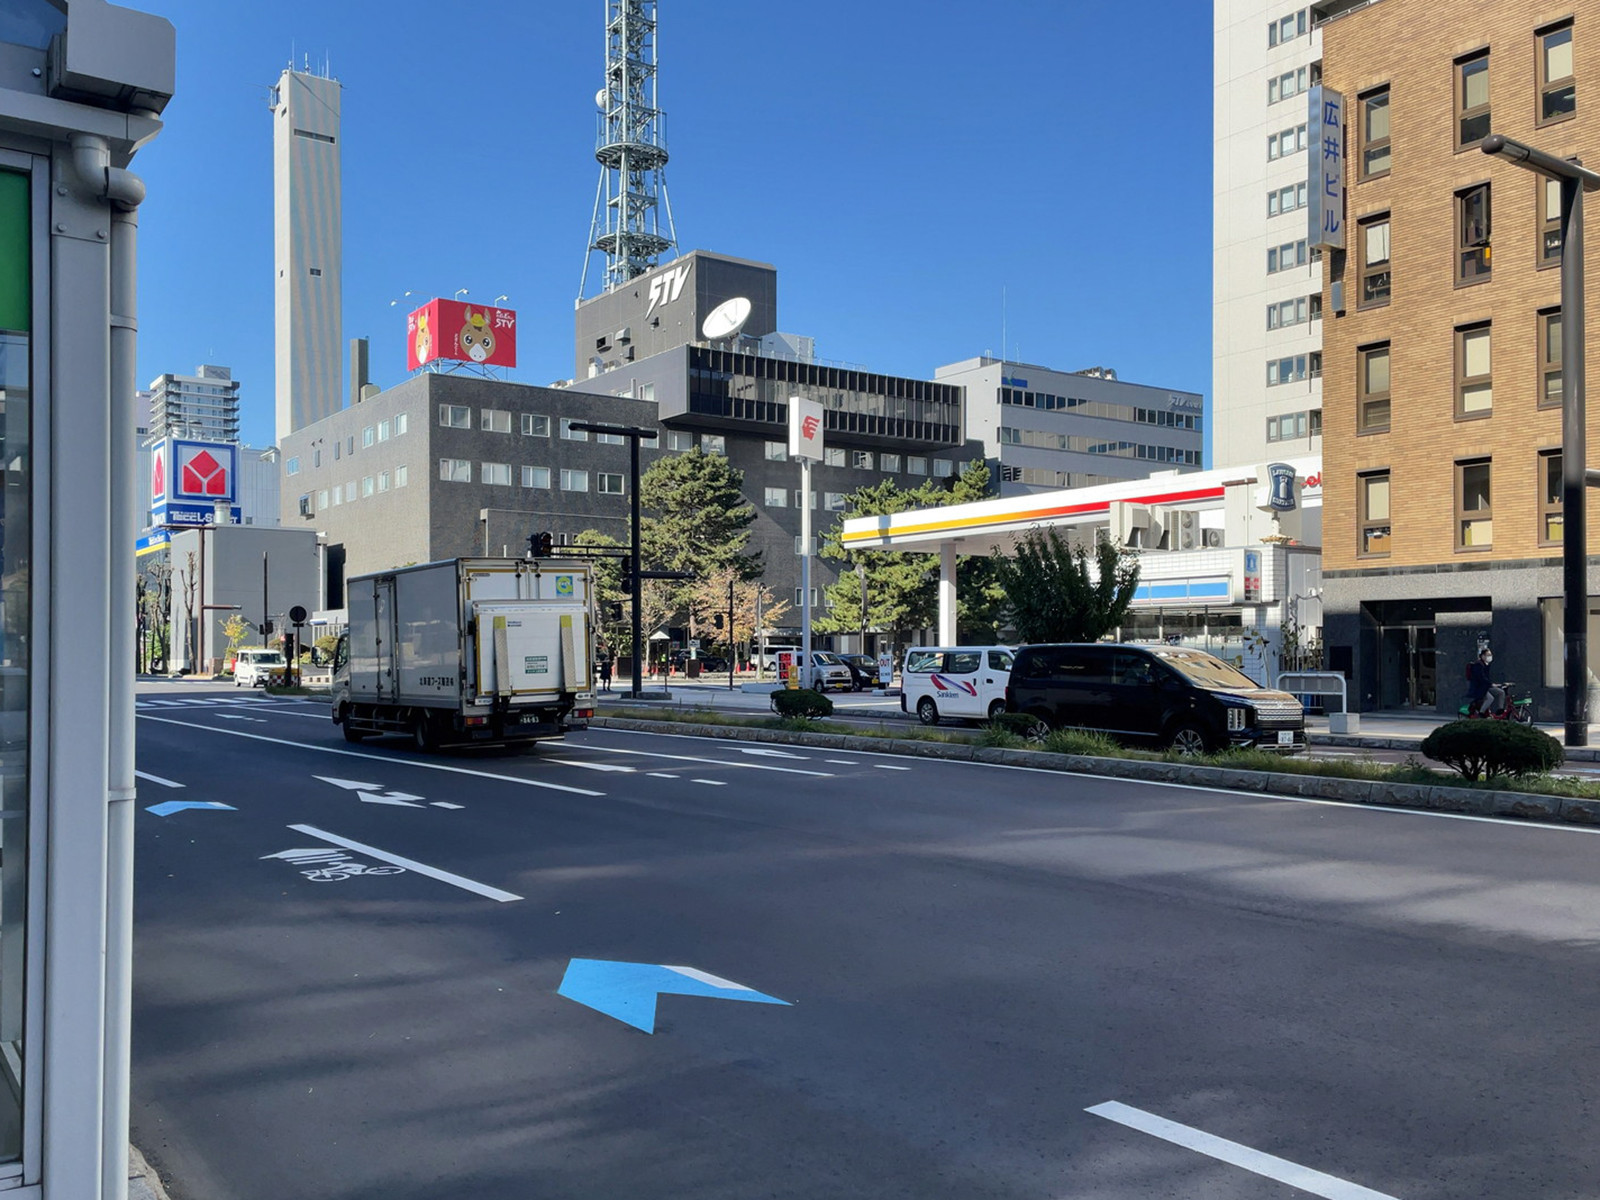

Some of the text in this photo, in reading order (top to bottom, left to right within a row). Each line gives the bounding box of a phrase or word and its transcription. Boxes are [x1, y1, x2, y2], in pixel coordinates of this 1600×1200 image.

[1323, 100, 1340, 233] 広井ビル
[644, 262, 693, 321] STV
[494, 318, 515, 329] STV
[880, 658, 890, 667] OUT
